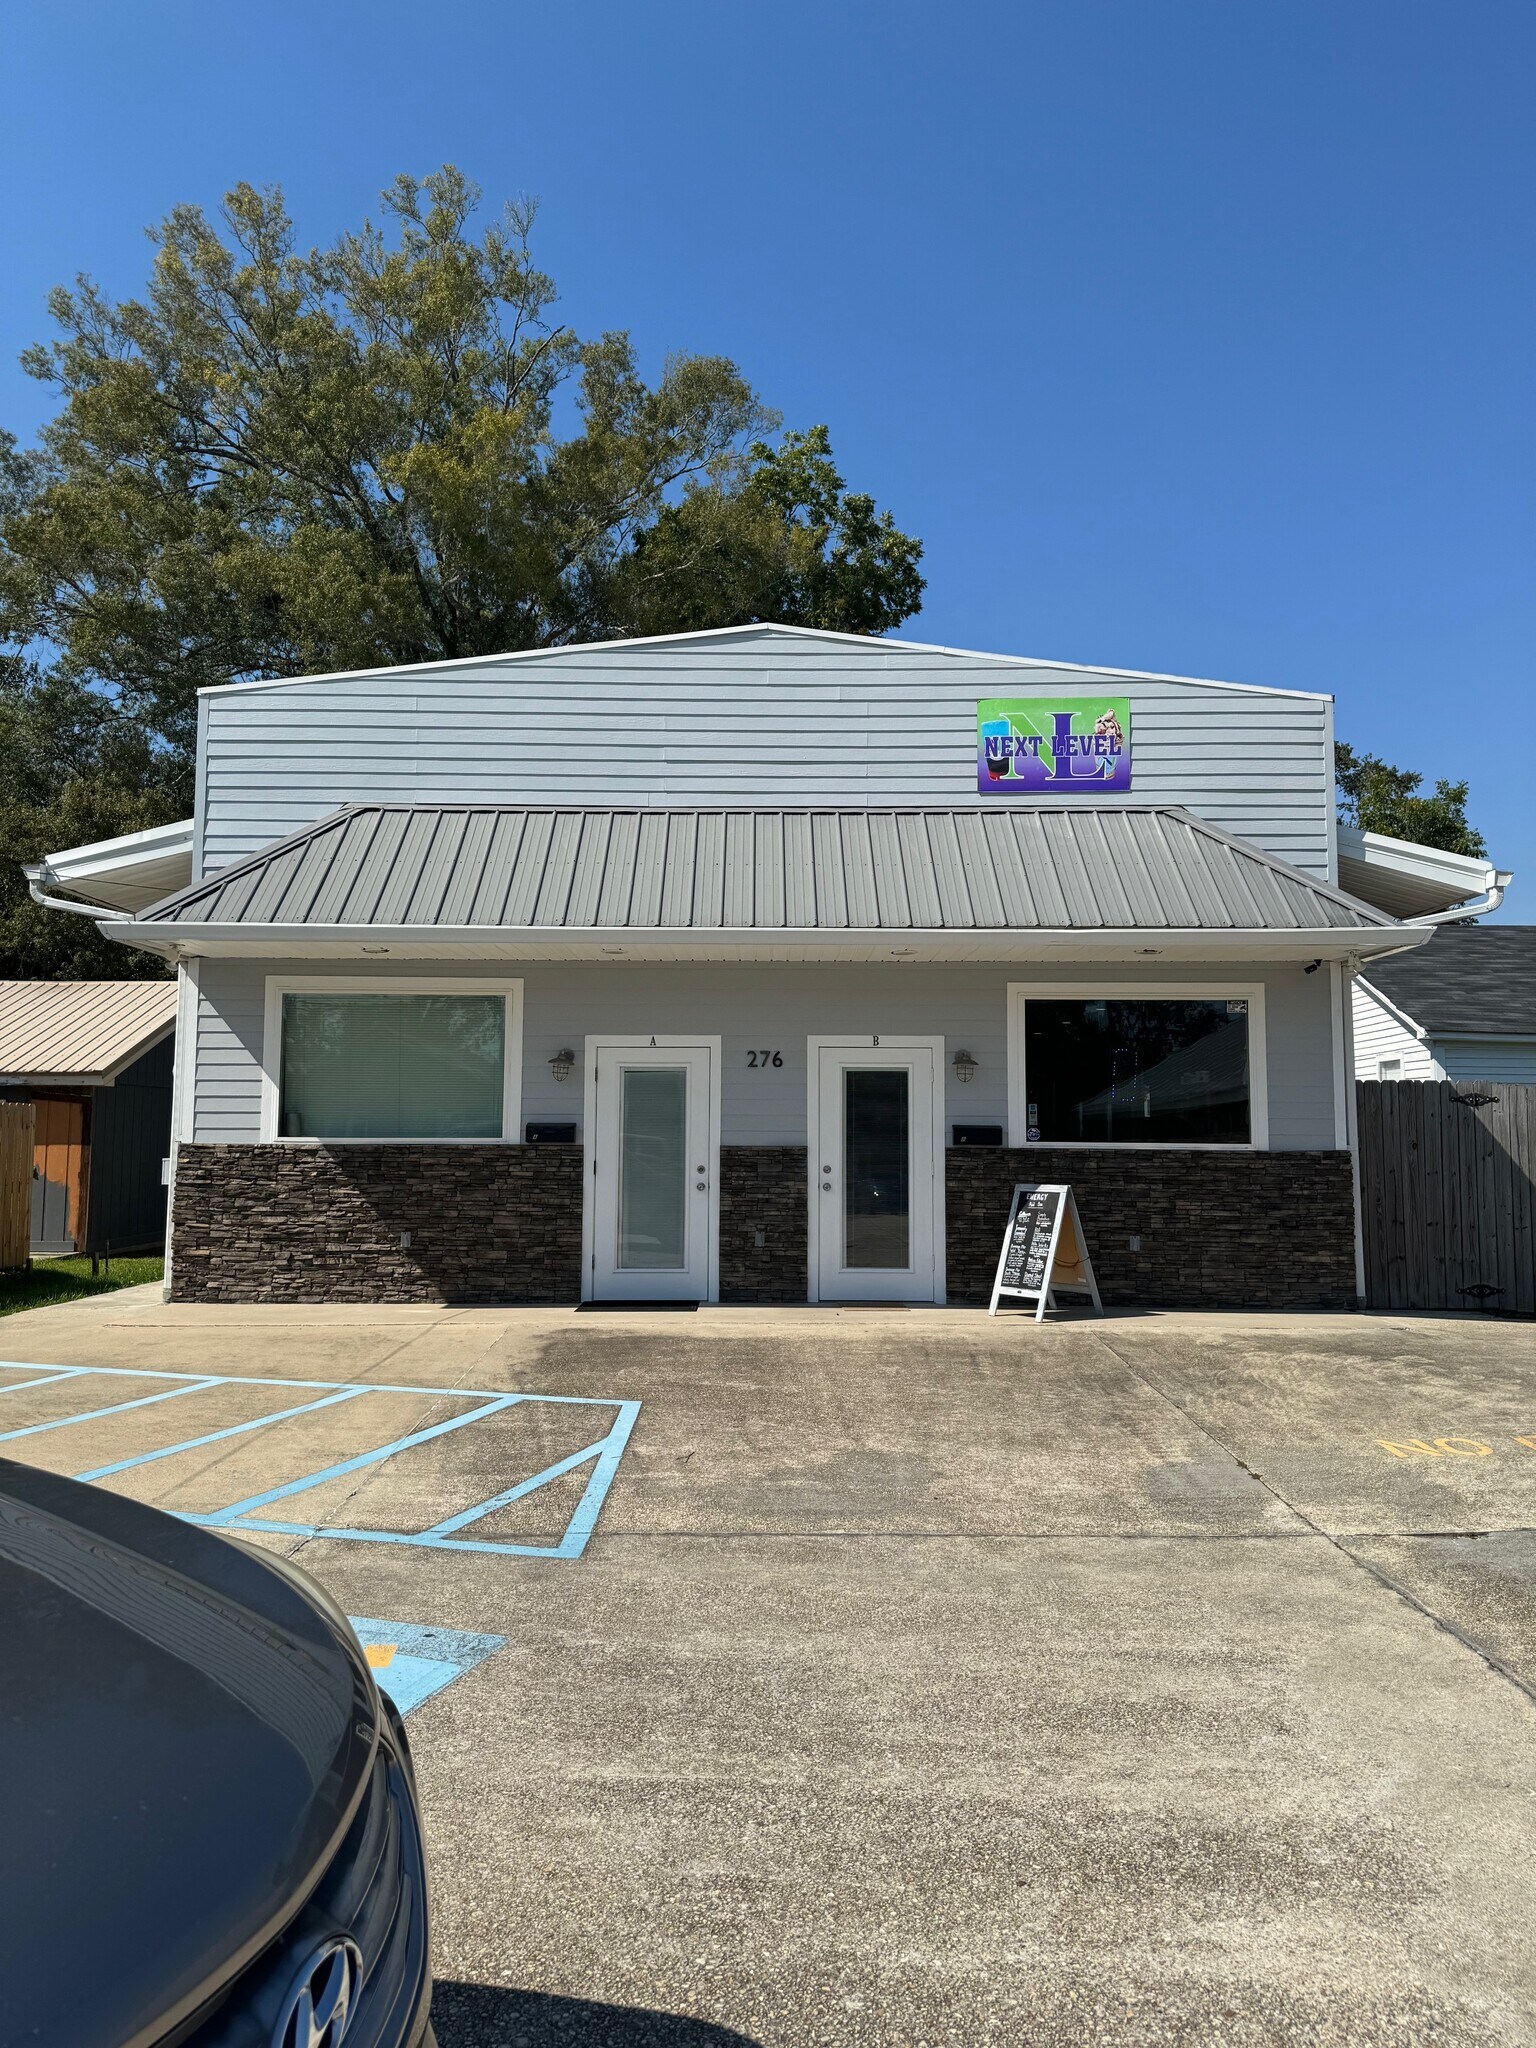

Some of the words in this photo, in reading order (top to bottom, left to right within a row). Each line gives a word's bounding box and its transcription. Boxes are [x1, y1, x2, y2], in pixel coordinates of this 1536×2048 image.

[984, 735, 1043, 758] NEXT
[1051, 734, 1122, 757] LEVEL
[650, 1036, 657, 1046] A
[873, 1036, 880, 1046] B
[747, 1050, 783, 1068] 276
[1373, 1437, 1493, 1458] NO
